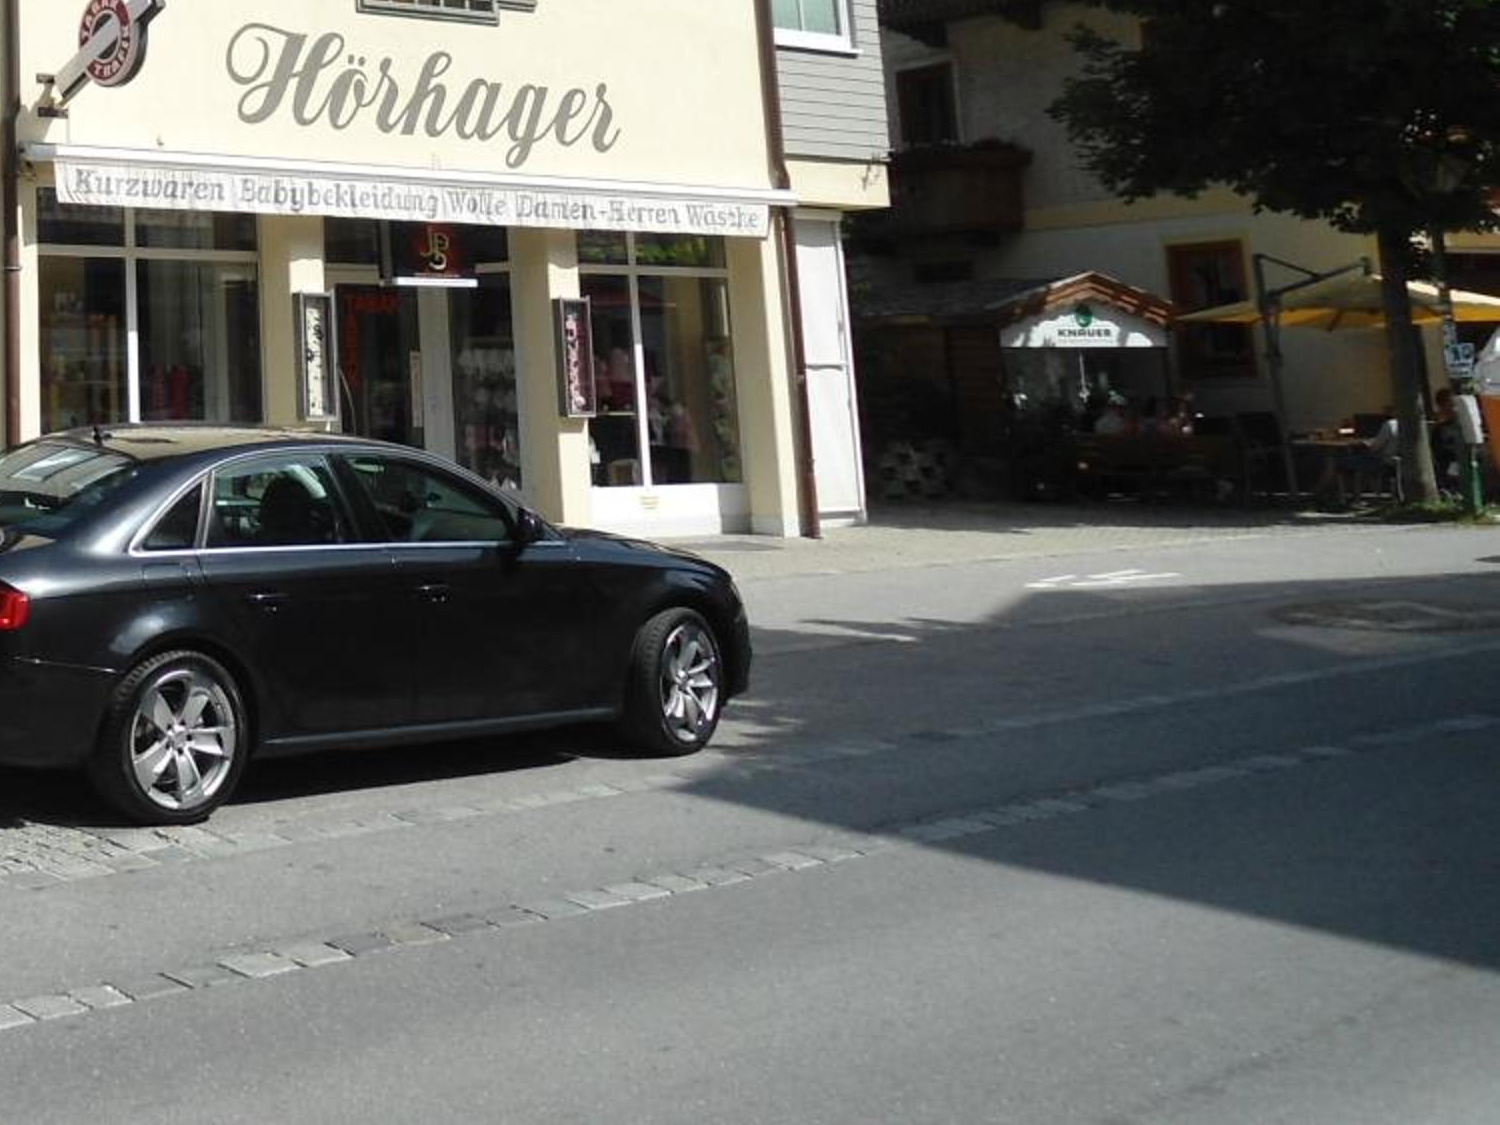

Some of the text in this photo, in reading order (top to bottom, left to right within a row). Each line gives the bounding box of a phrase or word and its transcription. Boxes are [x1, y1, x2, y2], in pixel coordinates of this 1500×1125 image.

[226, 22, 621, 169] Hörhager
[74, 169, 225, 201] Kurzwaren
[240, 177, 438, 216] Babybekleidung
[449, 191, 506, 218] Wolle
